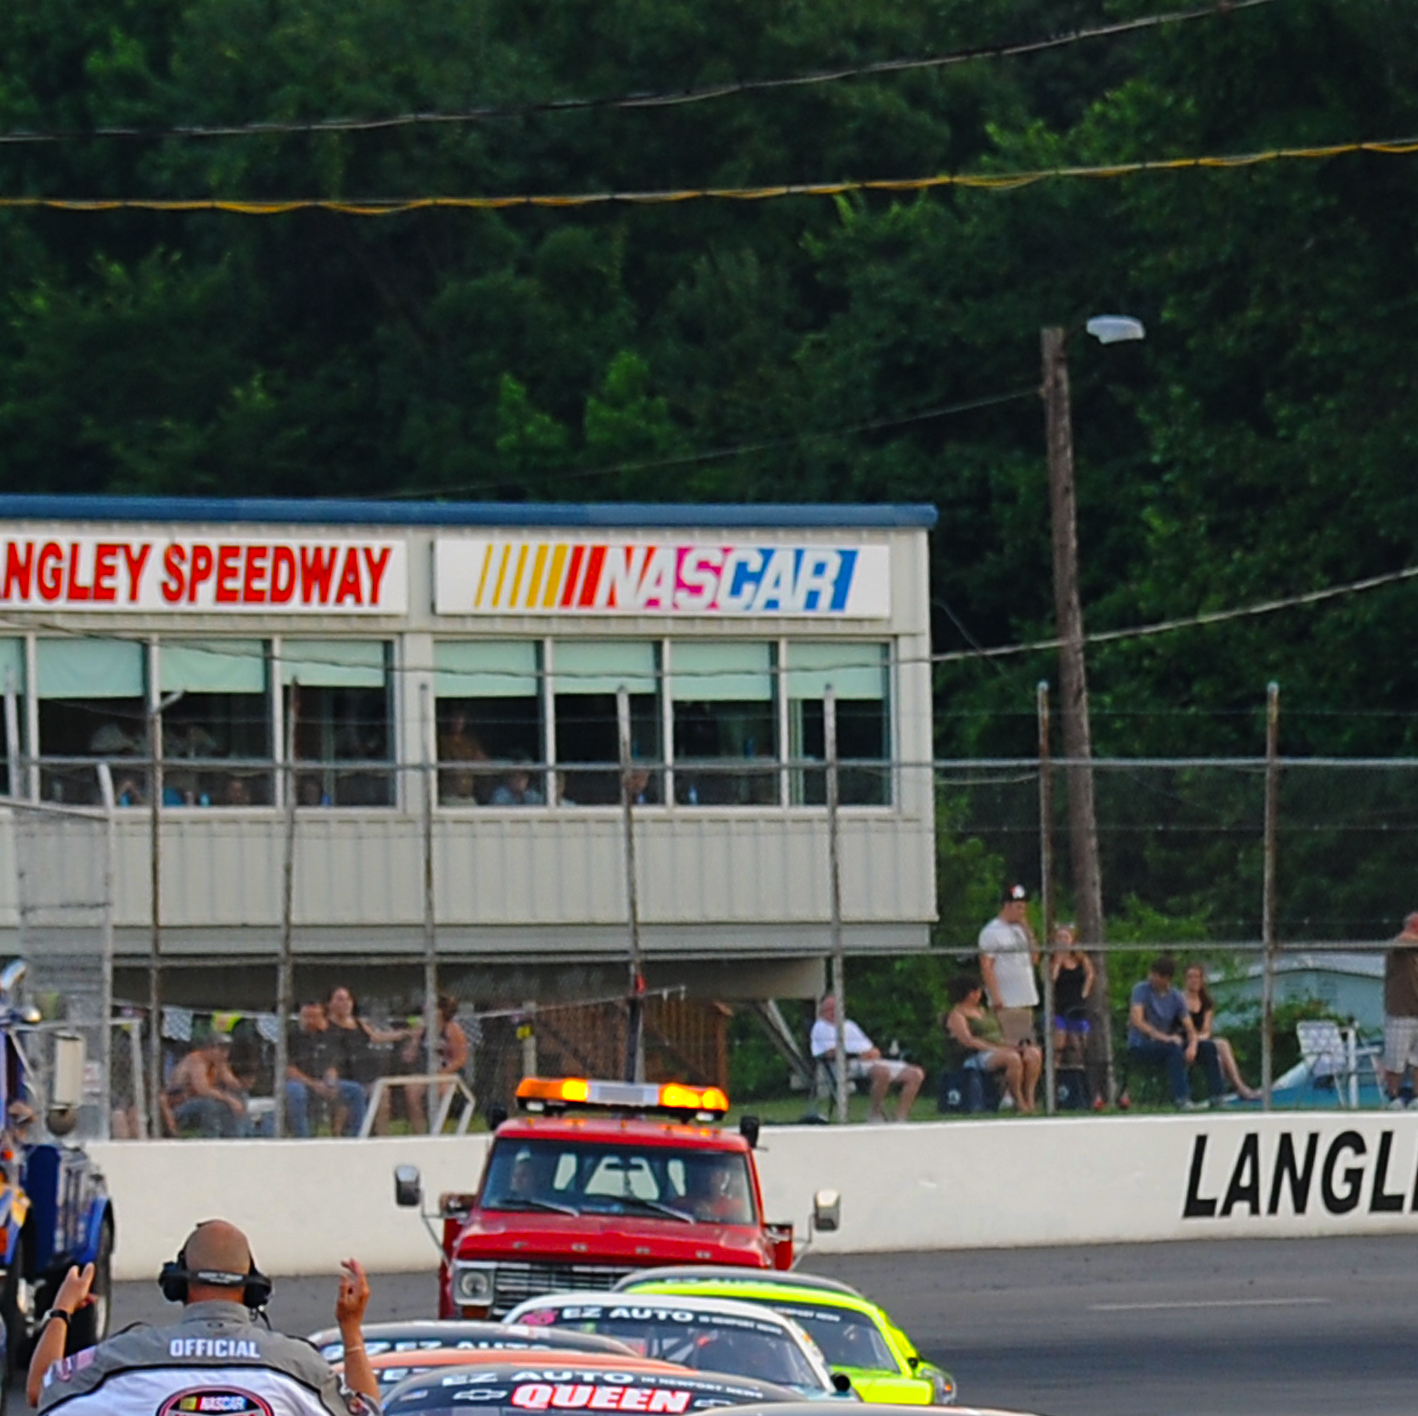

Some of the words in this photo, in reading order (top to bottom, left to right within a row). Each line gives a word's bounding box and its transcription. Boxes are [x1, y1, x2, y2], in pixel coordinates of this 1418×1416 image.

[160, 541, 392, 605] SPEEDWAY
[606, 546, 859, 612] NASCAR
[562, 1308, 601, 1319] EZ
[609, 1308, 693, 1321] AUTO
[170, 1339, 260, 1358] OFFICIAL
[443, 1373, 497, 1387] EZ
[511, 1370, 634, 1384] AUTO
[641, 1376, 656, 1385] IN
[658, 1377, 723, 1394] NEWPORT
[726, 1384, 763, 1398] NEWS
[511, 1384, 691, 1412] QUEEN
